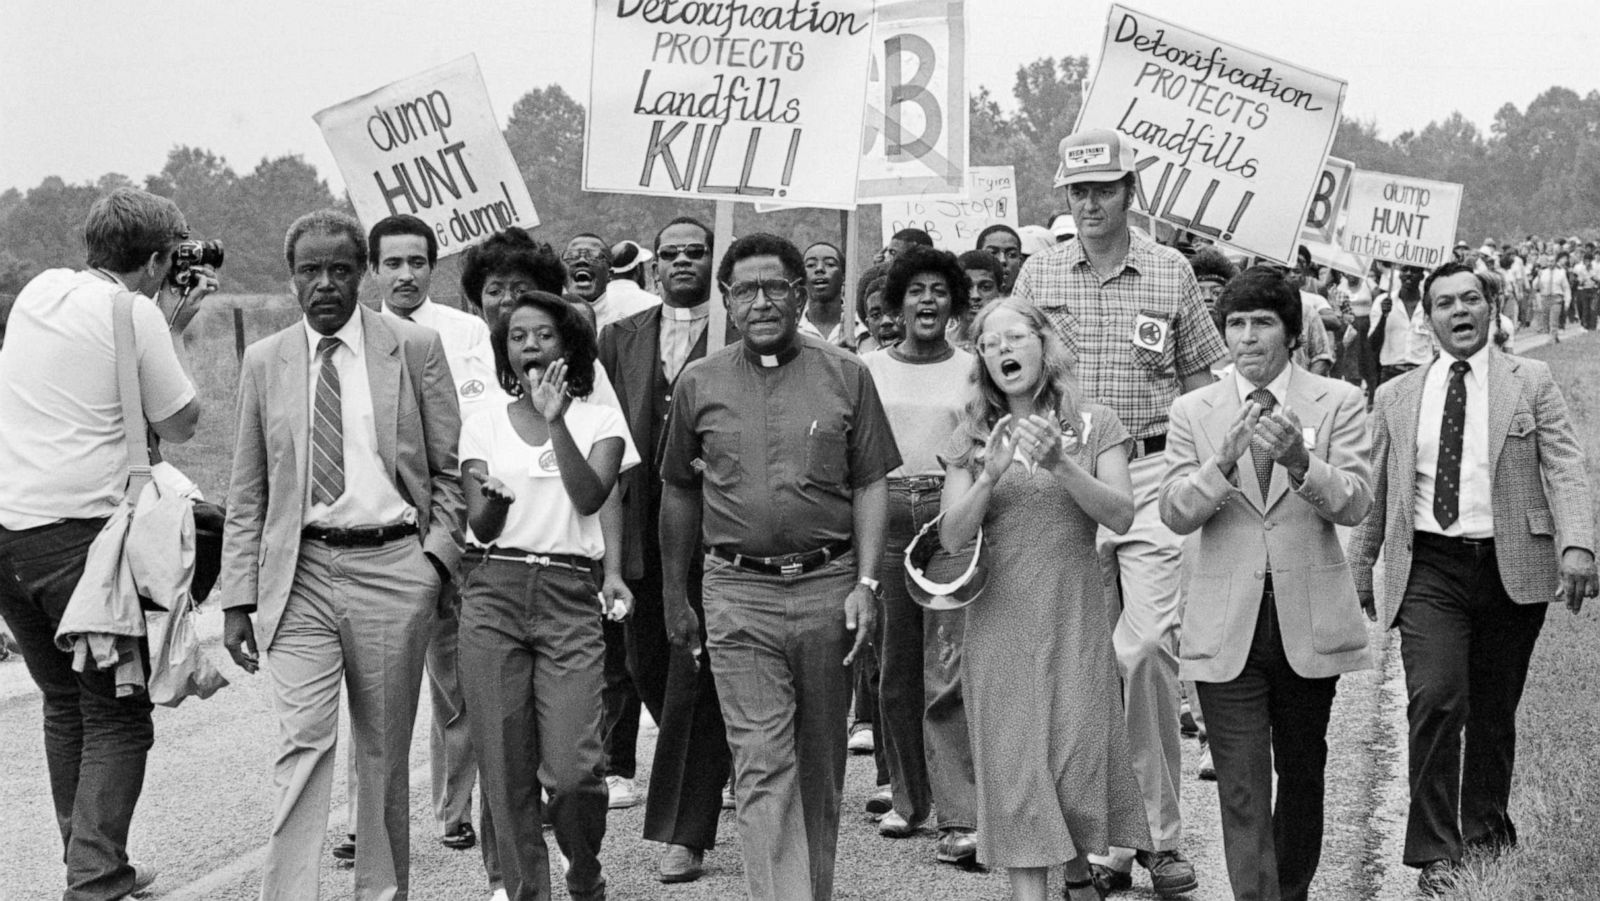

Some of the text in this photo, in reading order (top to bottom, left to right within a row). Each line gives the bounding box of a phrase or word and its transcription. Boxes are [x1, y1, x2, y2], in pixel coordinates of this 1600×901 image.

[651, 31, 805, 71] PROTECTS
[1114, 14, 1323, 111] Detoxification
[367, 90, 451, 151] dump
[634, 69, 800, 125] Landfills
[1133, 62, 1270, 130] PROTECTS
[639, 120, 802, 197] KILL!
[1116, 97, 1259, 178] Landfills
[373, 141, 479, 216] HUNT
[1383, 181, 1430, 212] dump
[1350, 231, 1446, 266] in the dump!
[1371, 207, 1430, 240] HUNT
